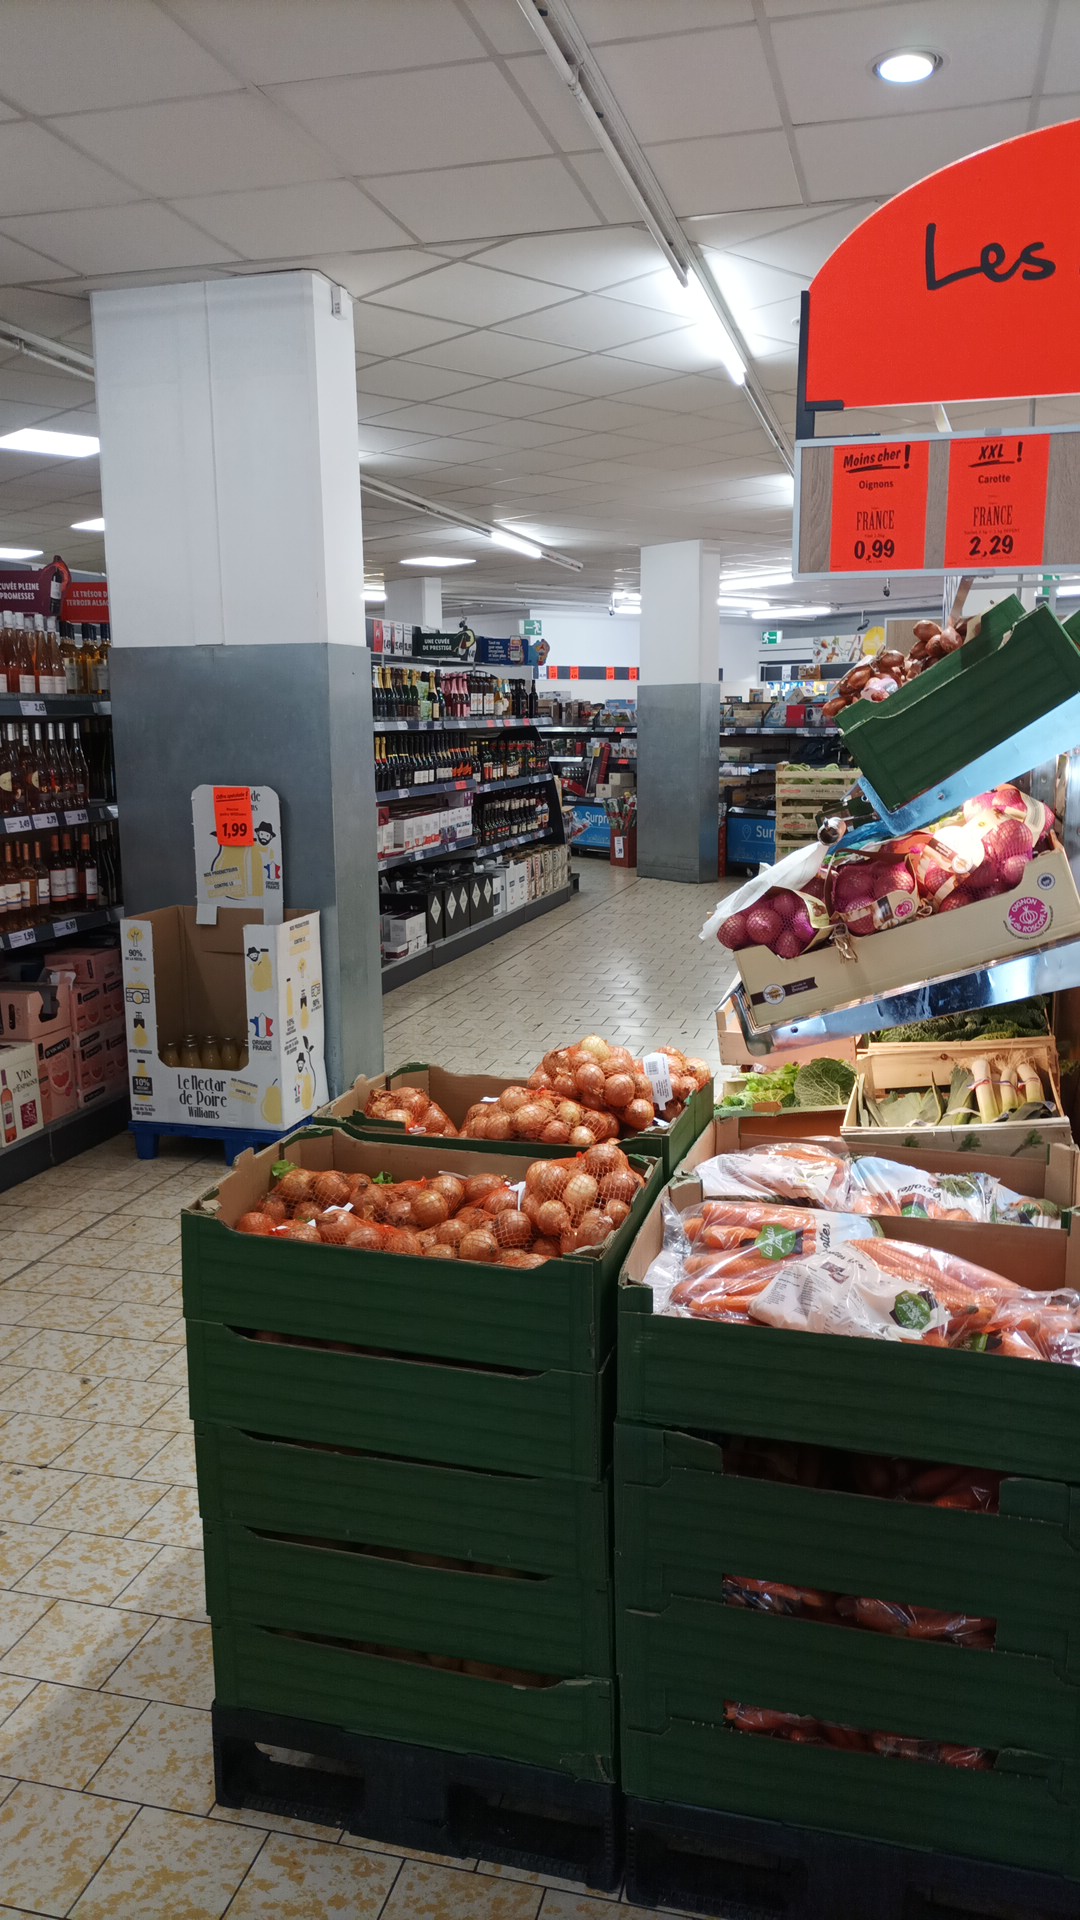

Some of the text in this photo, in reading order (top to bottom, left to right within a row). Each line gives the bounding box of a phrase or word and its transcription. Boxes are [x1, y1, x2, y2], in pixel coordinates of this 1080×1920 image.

[925, 222, 1057, 291] Les
[843, 444, 911, 470] Moins cher !
[978, 442, 1023, 462] XXL !
[858, 480, 894, 490] Oignons
[978, 474, 1011, 484] Carotte
[856, 510, 895, 531] FRANCE
[973, 505, 1013, 527] FRANCE
[854, 538, 895, 561] 0,99
[969, 534, 1014, 558] 2,29
[251, 790, 260, 802] de
[222, 822, 247, 839] 1,99
[1012, 898, 1037, 912] OIGNON
[128, 949, 143, 958] 90%
[16, 1068, 32, 1082] VIN
[135, 1078, 150, 1087] 10%
[177, 1074, 227, 1092] Le Nectar
[180, 1090, 227, 1108] de Poire
[188, 1106, 220, 1119] Williams
